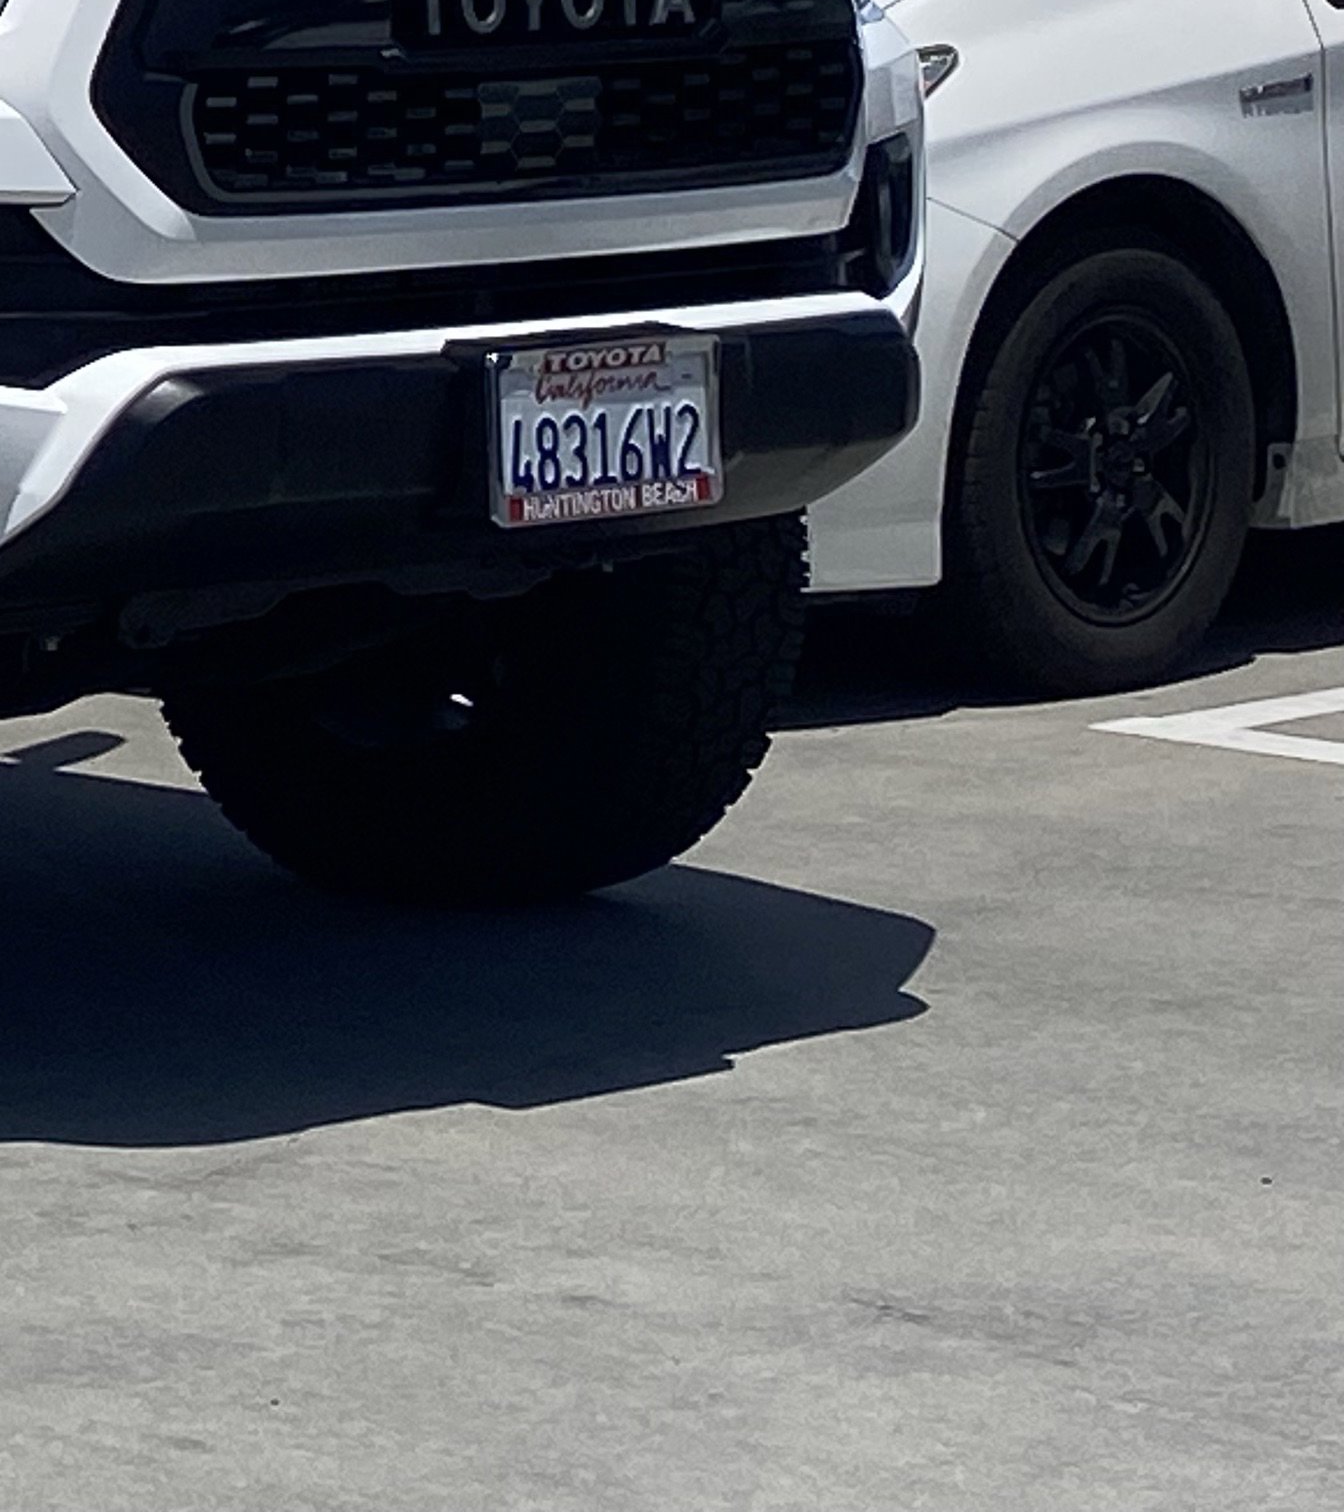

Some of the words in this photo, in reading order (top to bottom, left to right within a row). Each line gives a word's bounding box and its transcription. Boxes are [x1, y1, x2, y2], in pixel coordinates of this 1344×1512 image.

[545, 343, 663, 373] TOYOTA
[512, 402, 702, 493] 48316W2
[522, 486, 637, 522] HUNTINGTON
